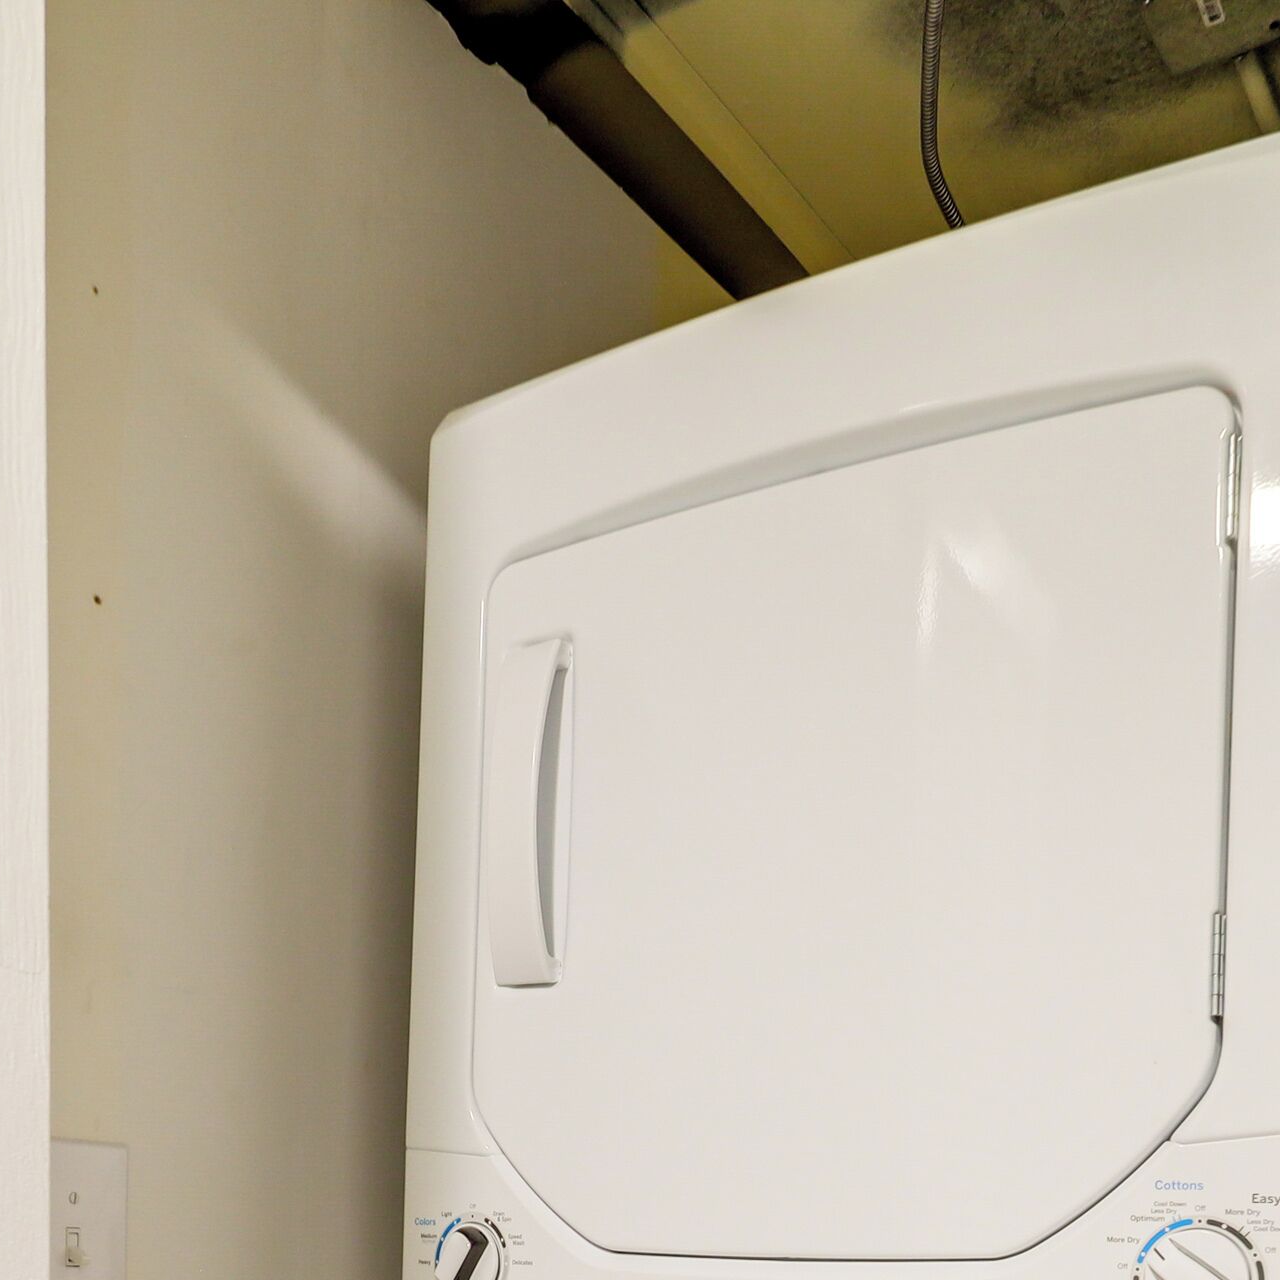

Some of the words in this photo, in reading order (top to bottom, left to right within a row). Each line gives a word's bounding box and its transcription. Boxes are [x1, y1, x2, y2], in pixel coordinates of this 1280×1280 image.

[1154, 1179, 1204, 1191] Cottons
[1251, 1193, 1280, 1206] Easy
[1246, 1209, 1261, 1217] Dry
[414, 1218, 436, 1226] Colors
[1130, 1215, 1166, 1223] Optimum
